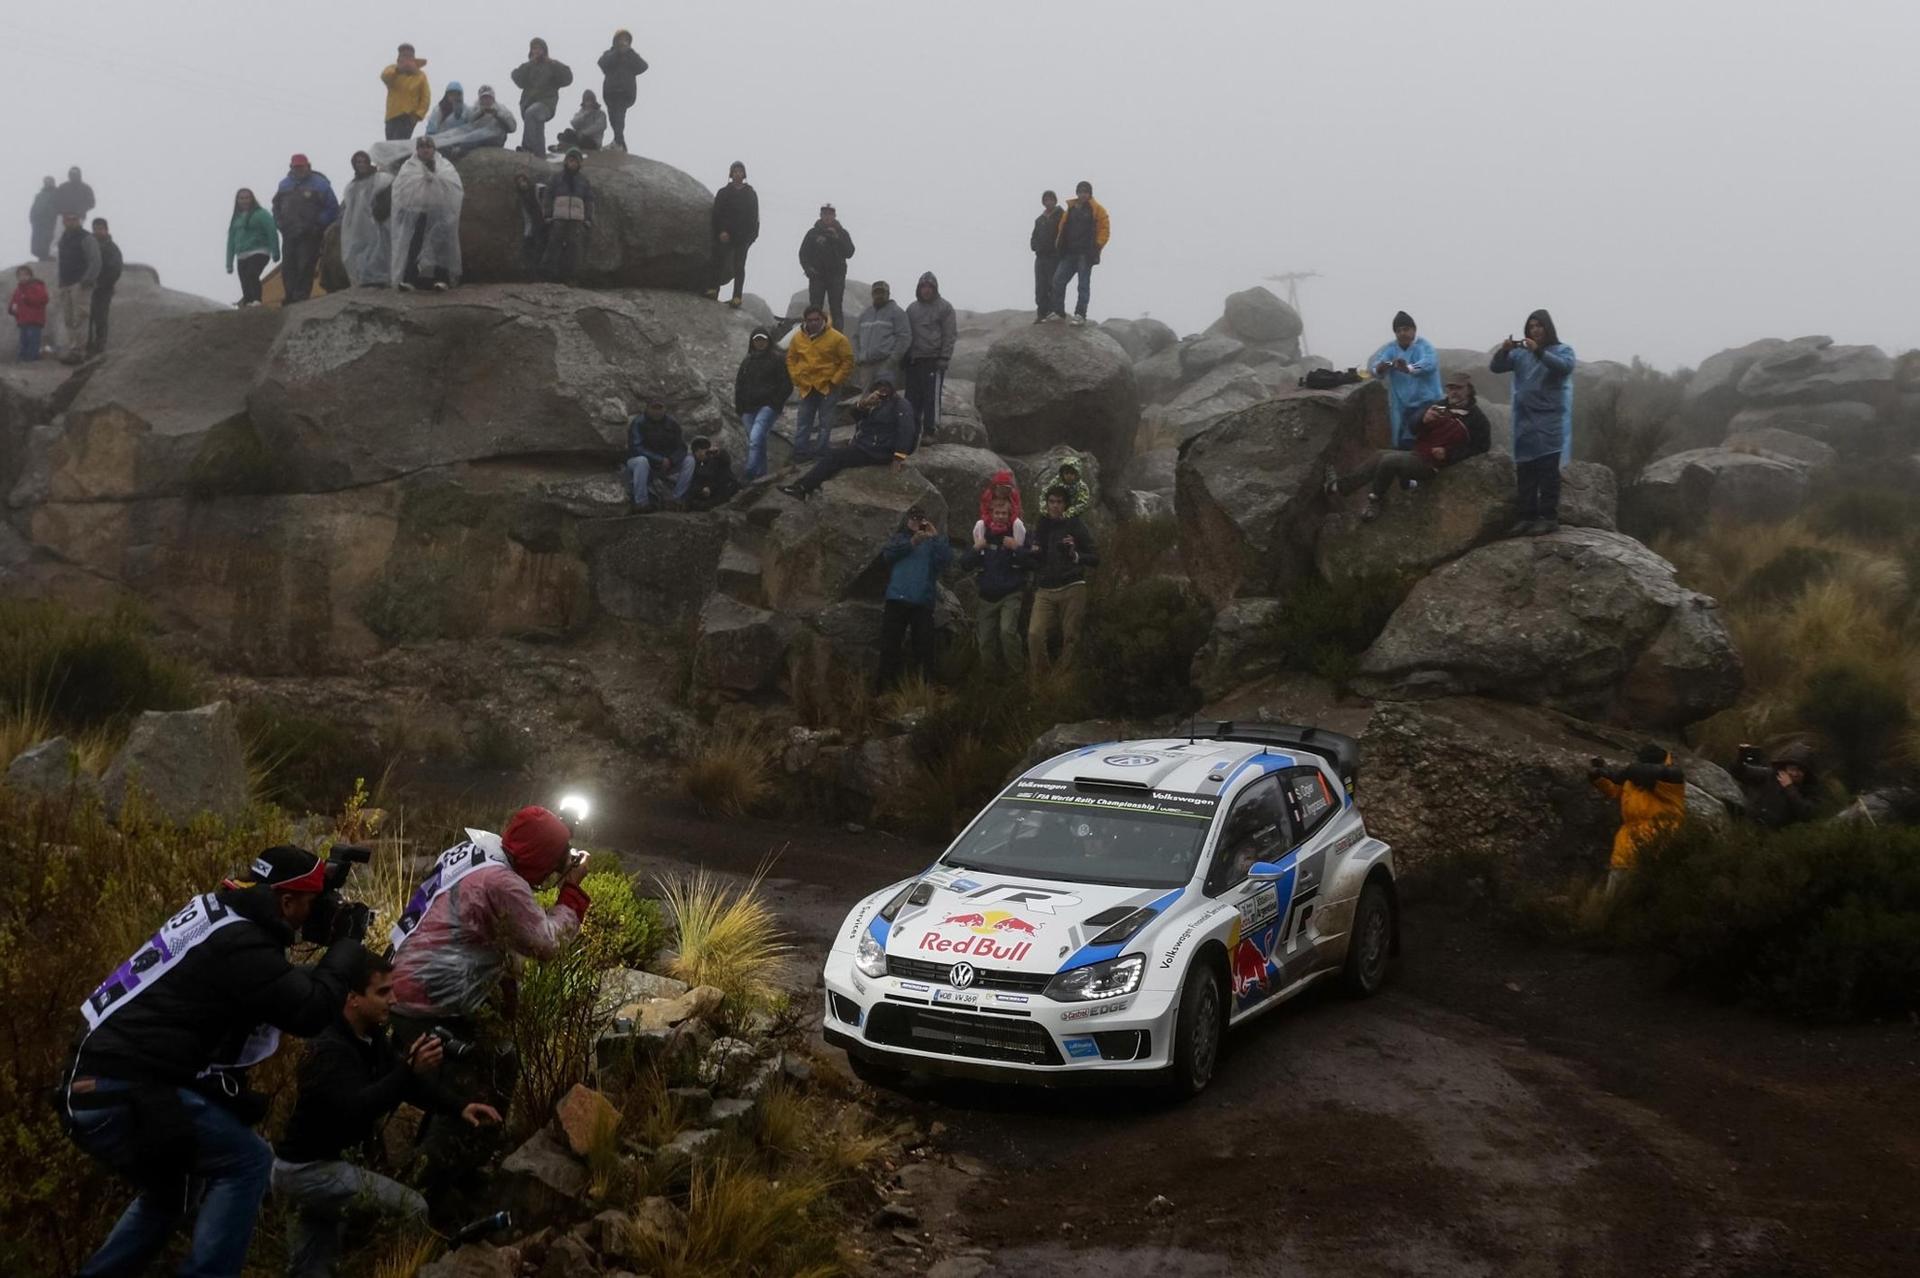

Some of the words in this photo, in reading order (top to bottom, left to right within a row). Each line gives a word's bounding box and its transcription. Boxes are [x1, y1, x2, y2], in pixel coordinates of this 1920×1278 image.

[1050, 795, 1073, 803] World
[1074, 797, 1095, 805] Rally
[1096, 798, 1155, 810] Championship
[1152, 792, 1214, 806] Volkswagen
[918, 931, 977, 955] Red
[972, 937, 1033, 962] Bull
[1160, 926, 1193, 970] Volkswagen
[1090, 1001, 1129, 1016] EDGE
